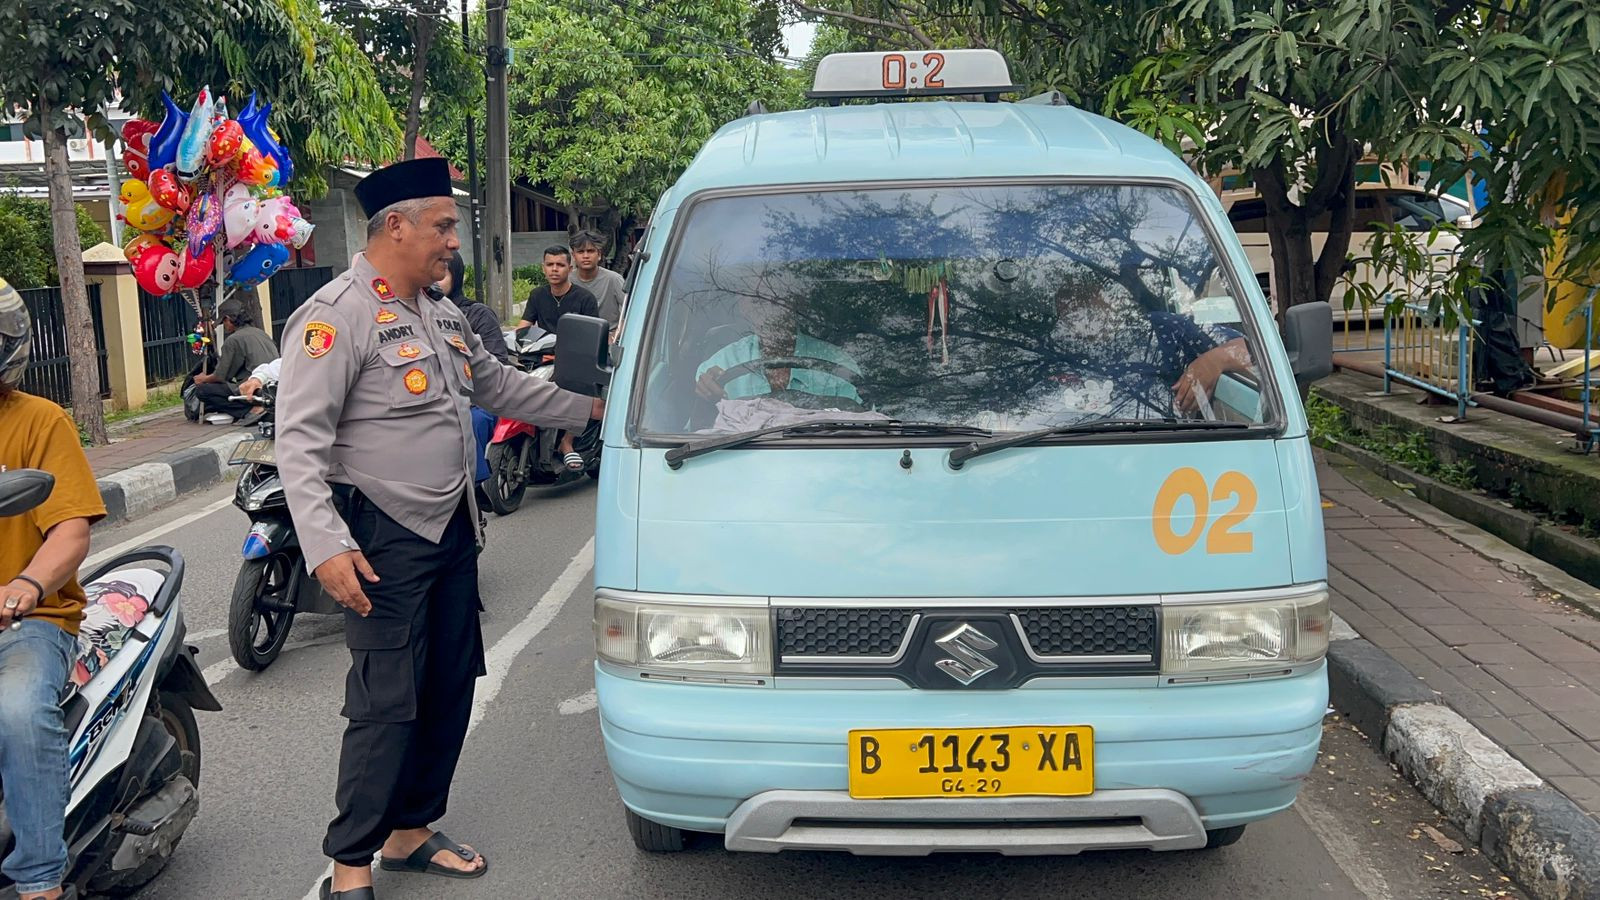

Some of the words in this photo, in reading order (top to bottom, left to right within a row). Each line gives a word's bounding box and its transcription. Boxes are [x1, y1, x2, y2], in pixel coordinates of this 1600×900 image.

[882, 53, 945, 89] 0:2
[378, 324, 414, 343] ANDRY
[436, 319, 462, 332] POLRI
[1152, 467, 1257, 555] 02
[860, 735, 882, 774] B
[918, 734, 1010, 774] 1143
[1037, 733, 1083, 771] XA
